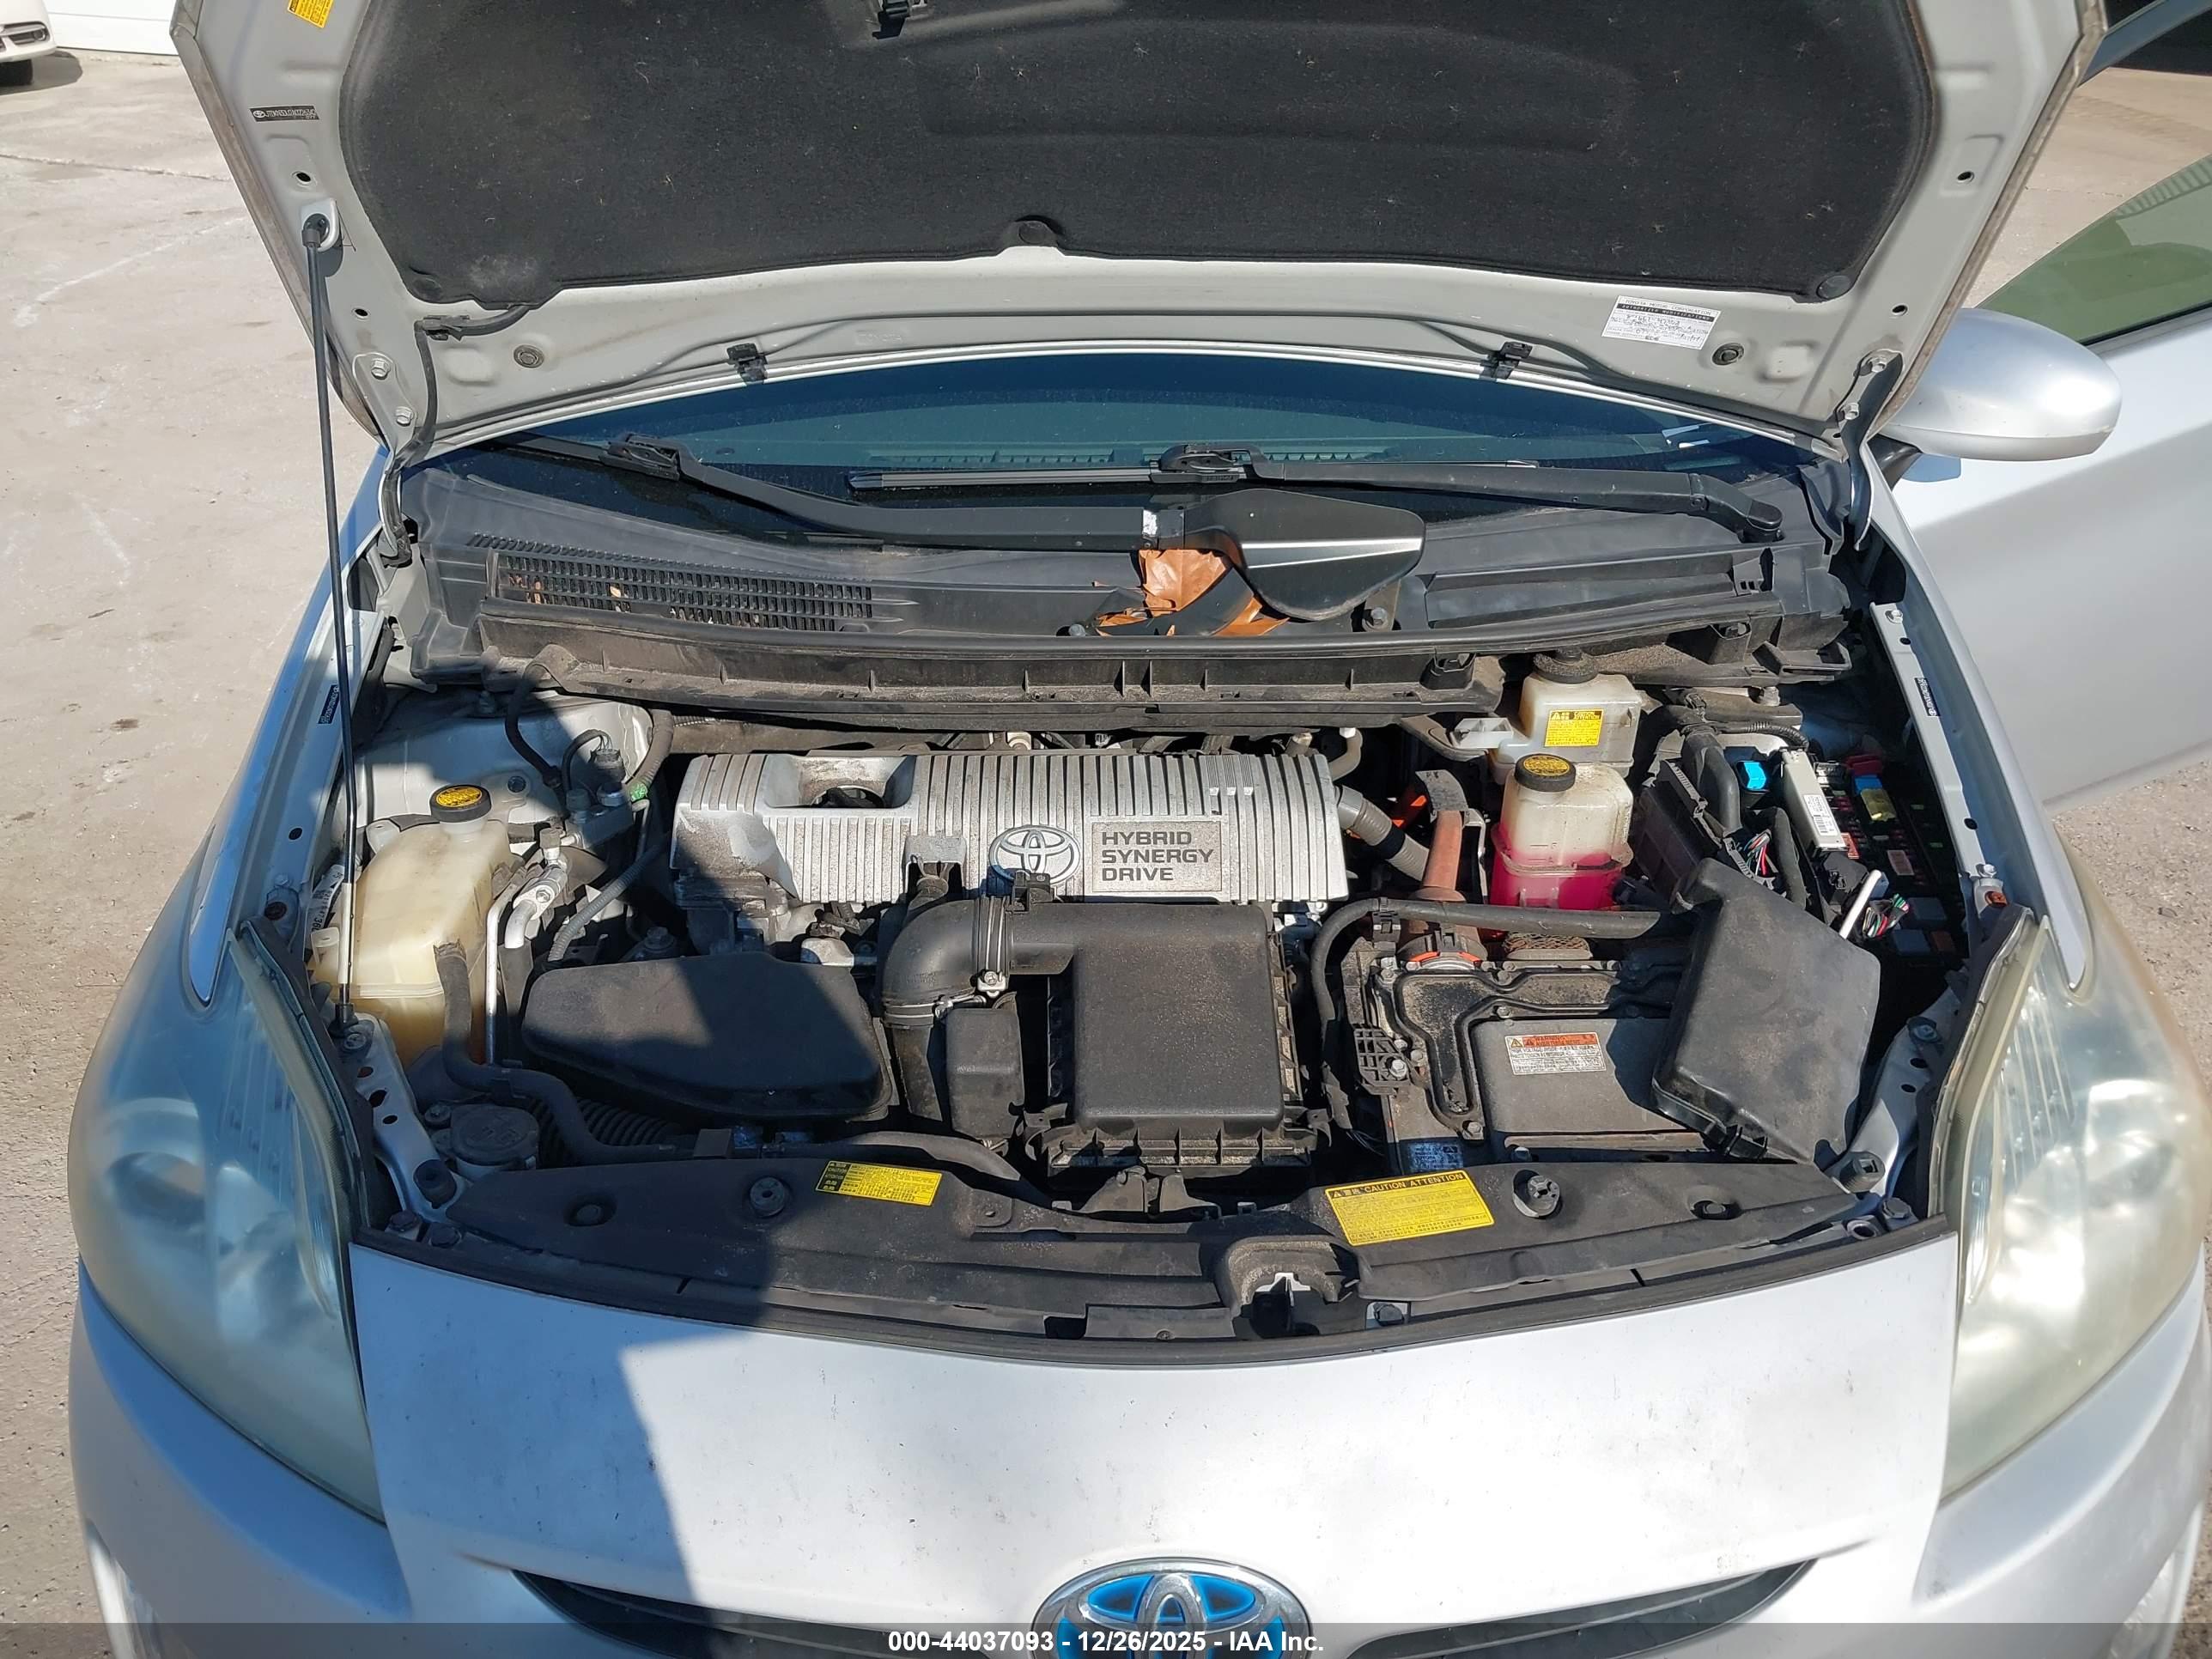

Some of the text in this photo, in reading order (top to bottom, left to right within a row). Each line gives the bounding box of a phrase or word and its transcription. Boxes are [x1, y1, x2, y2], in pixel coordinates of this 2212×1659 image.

[1102, 831, 1192, 845] HYBRID
[1102, 848, 1214, 863] SYNERGY
[1102, 867, 1174, 881] DRIVE
[1364, 1181, 1407, 1193] CAUTION
[1409, 1173, 1464, 1188] ATTENTION
